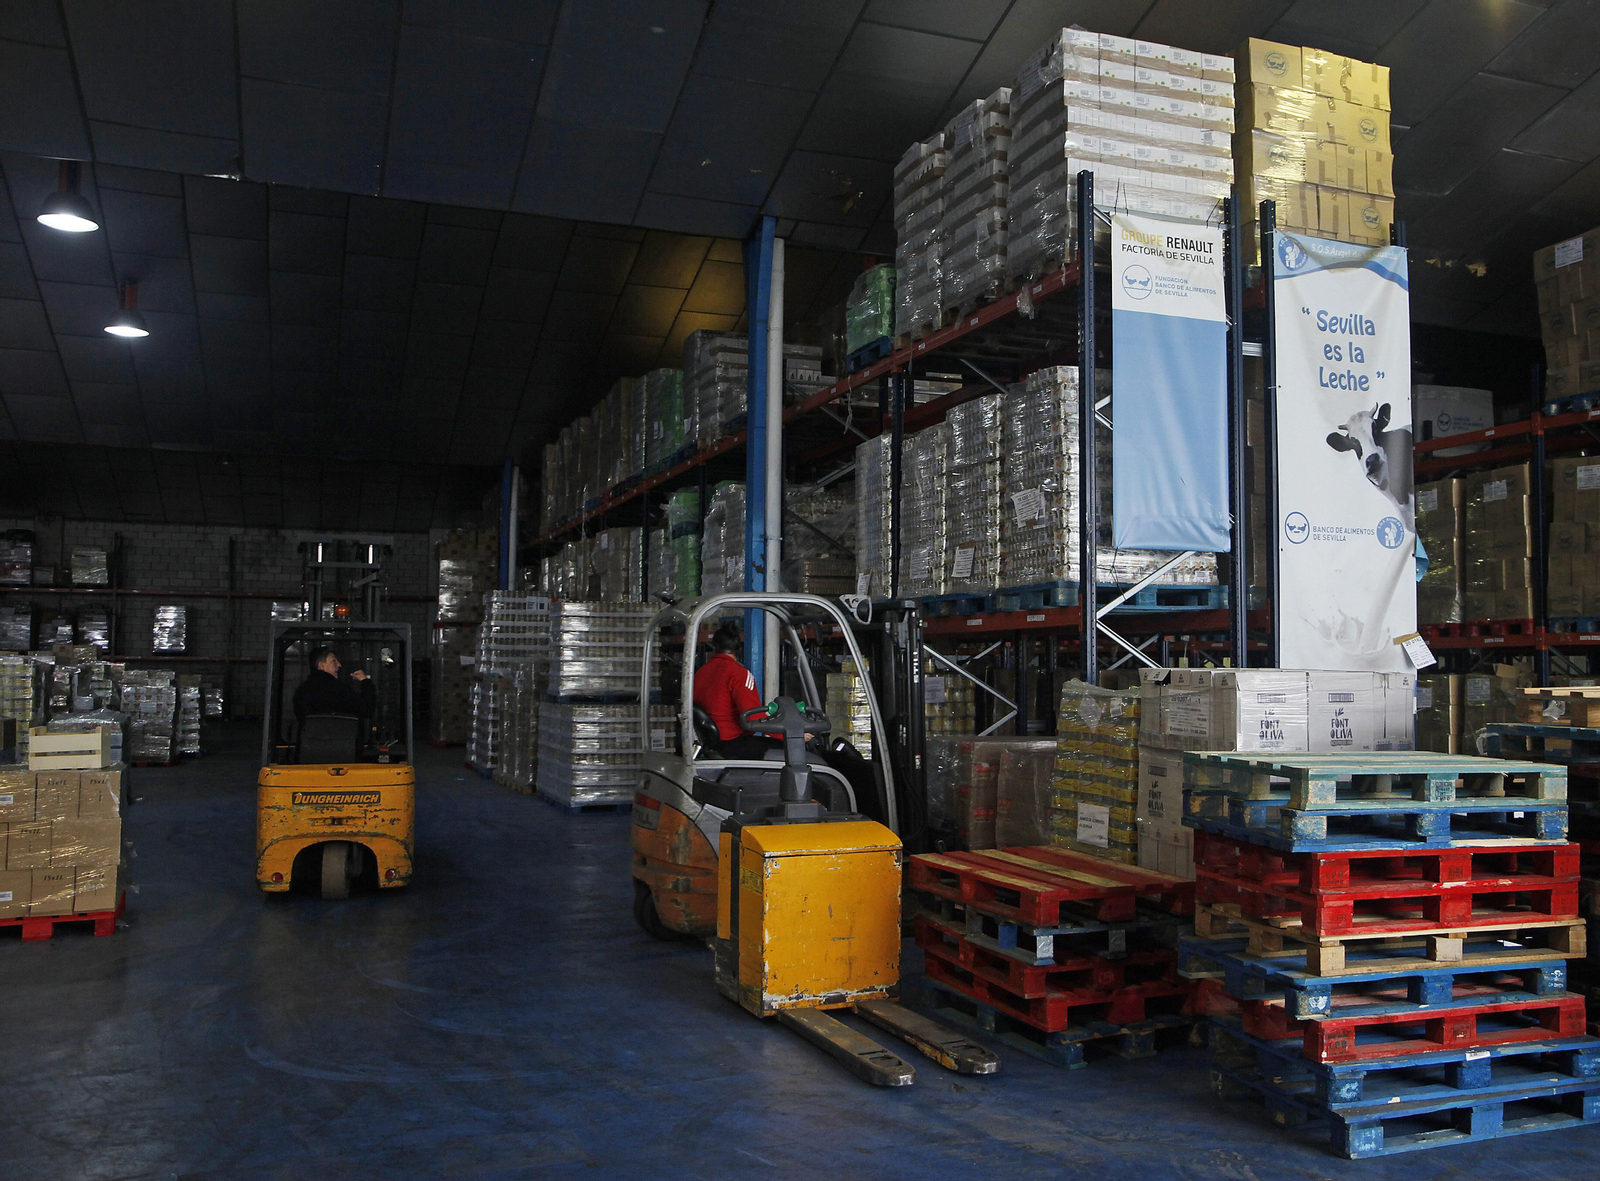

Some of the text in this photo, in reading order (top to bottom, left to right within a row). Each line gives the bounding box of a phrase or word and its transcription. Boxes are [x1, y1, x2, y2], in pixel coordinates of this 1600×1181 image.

[1121, 228, 1214, 254] GROUPE RENAULT
[1121, 243, 1215, 265] FACTORÍA DE SEVILLA
[1164, 289, 1189, 298] SEVILLA
[1186, 286, 1217, 295] ALIMENTOS
[1324, 341, 1365, 363] es la
[1344, 527, 1375, 536] ALIMENTOS
[1313, 533, 1347, 542] DE SEVILLA
[1260, 719, 1280, 729] FONT
[1331, 718, 1349, 728] FONT
[1259, 730, 1284, 740] OLIVA
[1330, 728, 1353, 739] OLIVA
